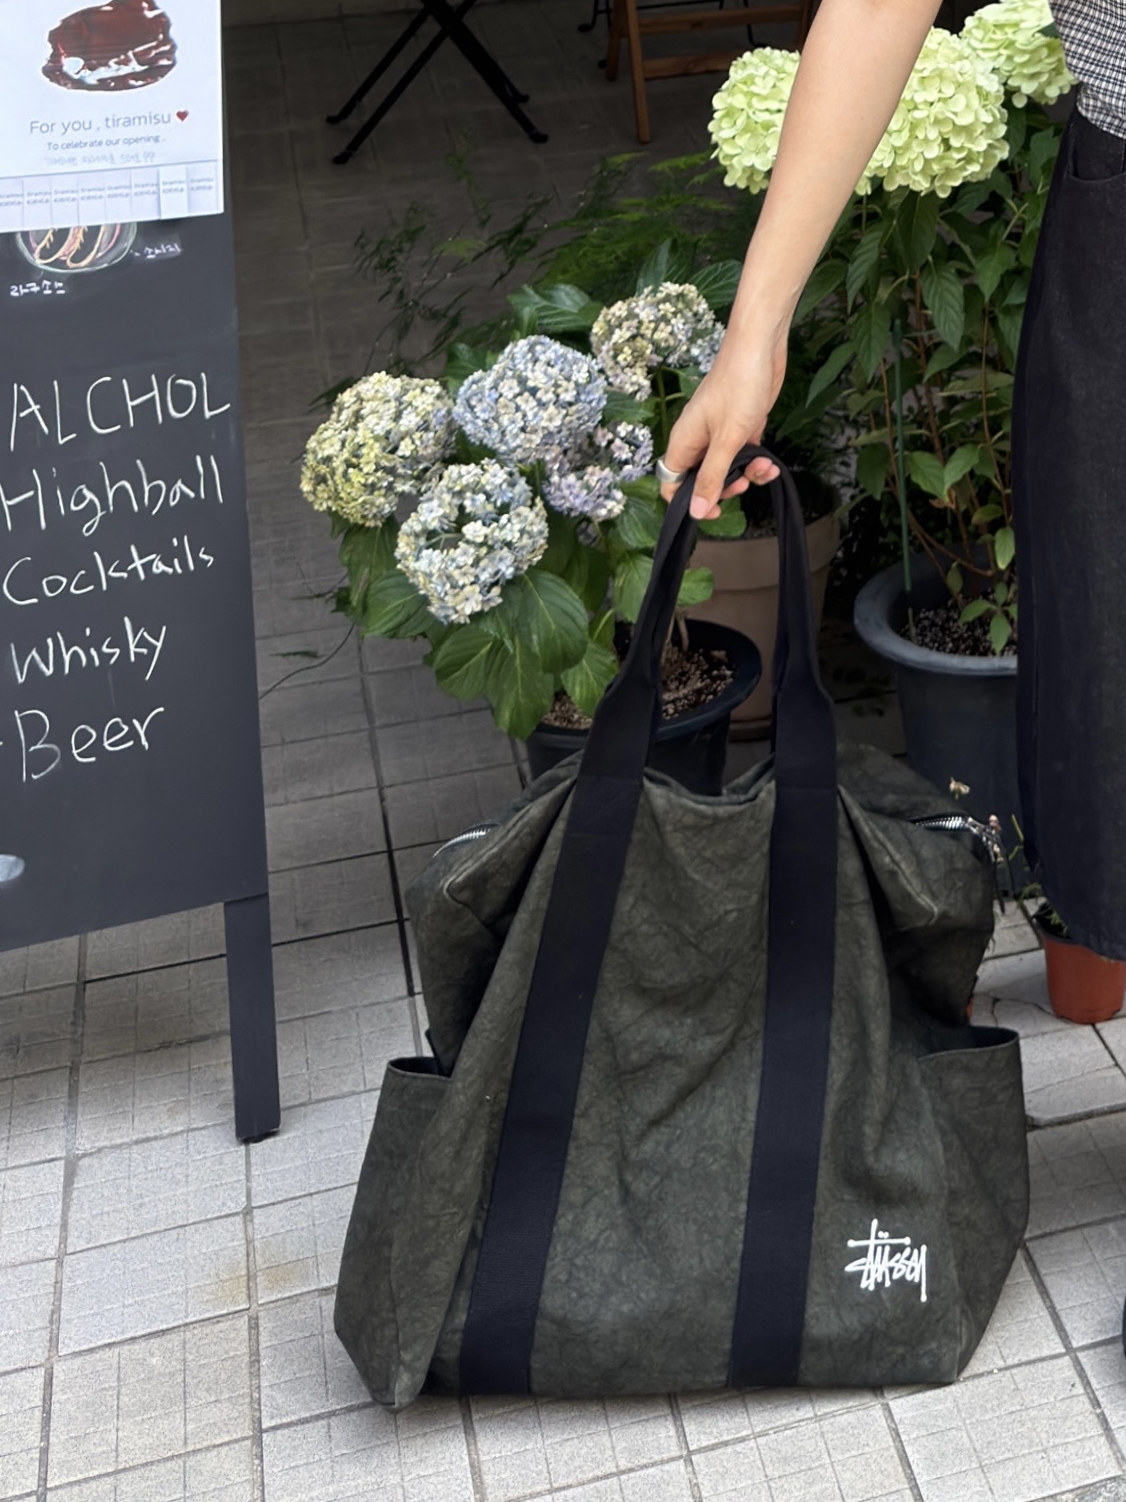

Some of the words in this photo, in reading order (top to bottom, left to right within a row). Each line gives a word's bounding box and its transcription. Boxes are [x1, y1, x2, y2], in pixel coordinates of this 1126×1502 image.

[29, 120, 56, 135] For
[105, 111, 171, 130] tiramisu
[47, 142, 59, 151] To
[60, 138, 103, 151] celebrate
[105, 139, 121, 147] our
[10, 372, 230, 451] ALCHOL
[0, 455, 223, 537] Highball
[3, 535, 214, 605] Cocktails
[11, 616, 167, 684] Whisky
[14, 706, 165, 783] Beer
